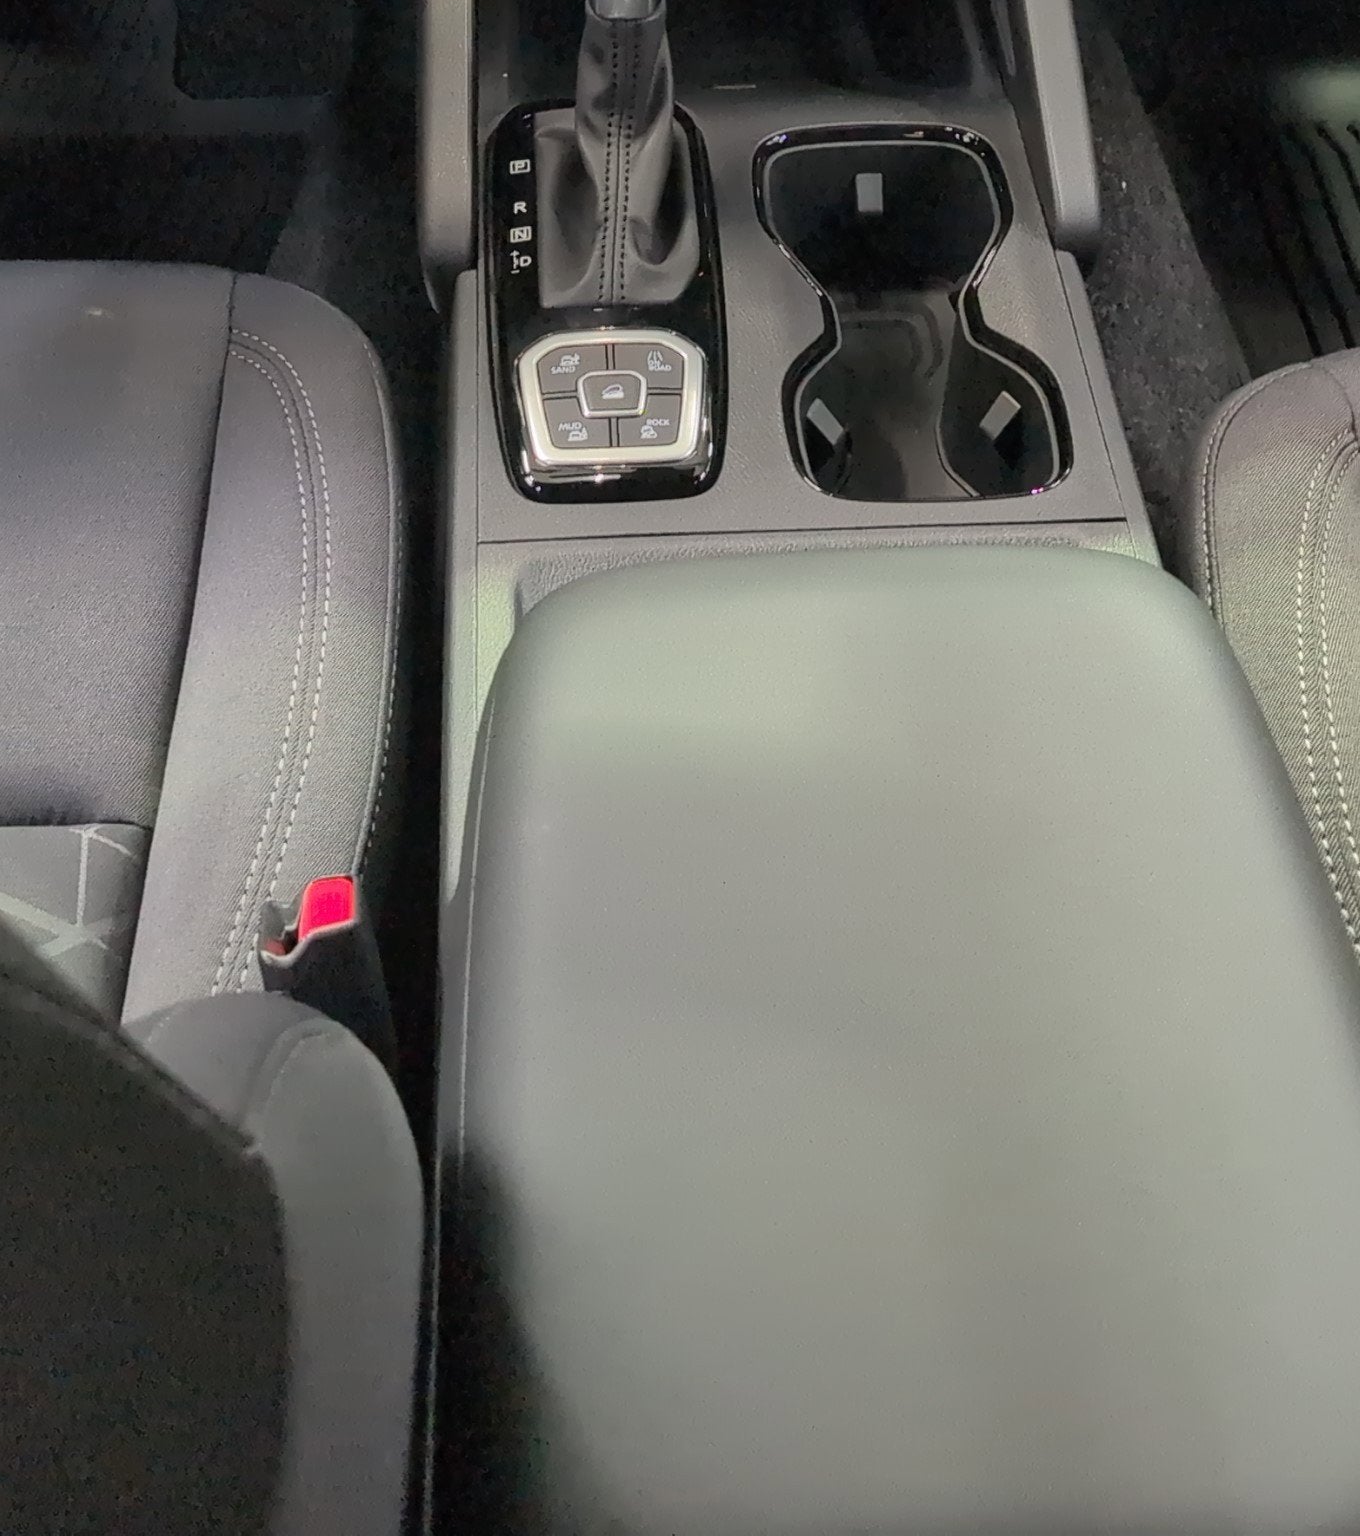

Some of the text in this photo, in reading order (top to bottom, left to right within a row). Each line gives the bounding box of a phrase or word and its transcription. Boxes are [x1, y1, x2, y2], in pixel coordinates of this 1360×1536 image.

[513, 200, 528, 215] R
[520, 254, 532, 268] D
[551, 365, 576, 375] SAND
[558, 421, 582, 432] MUD
[646, 418, 670, 427] ROCK
